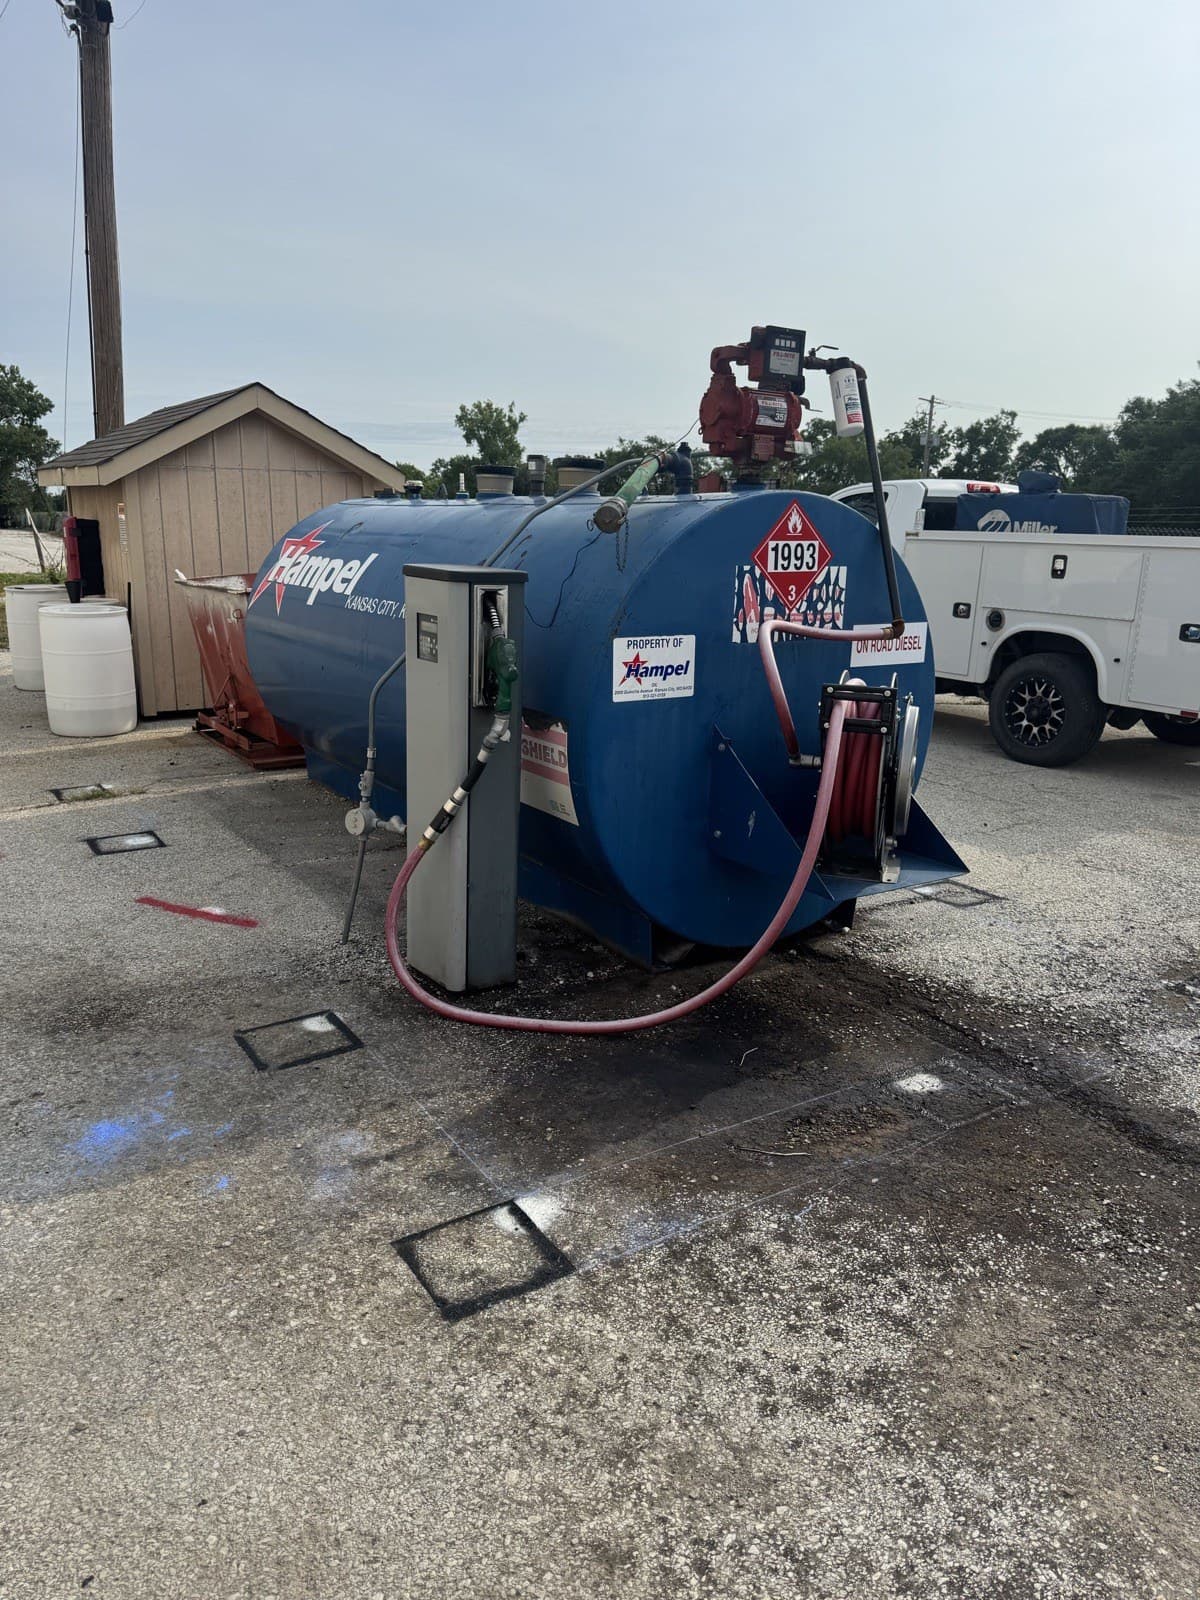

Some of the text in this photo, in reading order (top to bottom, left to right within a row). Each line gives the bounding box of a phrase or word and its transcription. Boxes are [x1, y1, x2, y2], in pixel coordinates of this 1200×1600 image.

[1014, 521, 1057, 533] Miller
[771, 543, 816, 571] 1993
[268, 545, 379, 606] Hampel
[788, 584, 796, 601] 3
[345, 595, 379, 614] KANSAS
[377, 600, 400, 620] CITY,
[627, 637, 684, 650] PROPERTY OF
[856, 635, 922, 653] ON ROAD DIESEL
[625, 660, 690, 681] Hampel
